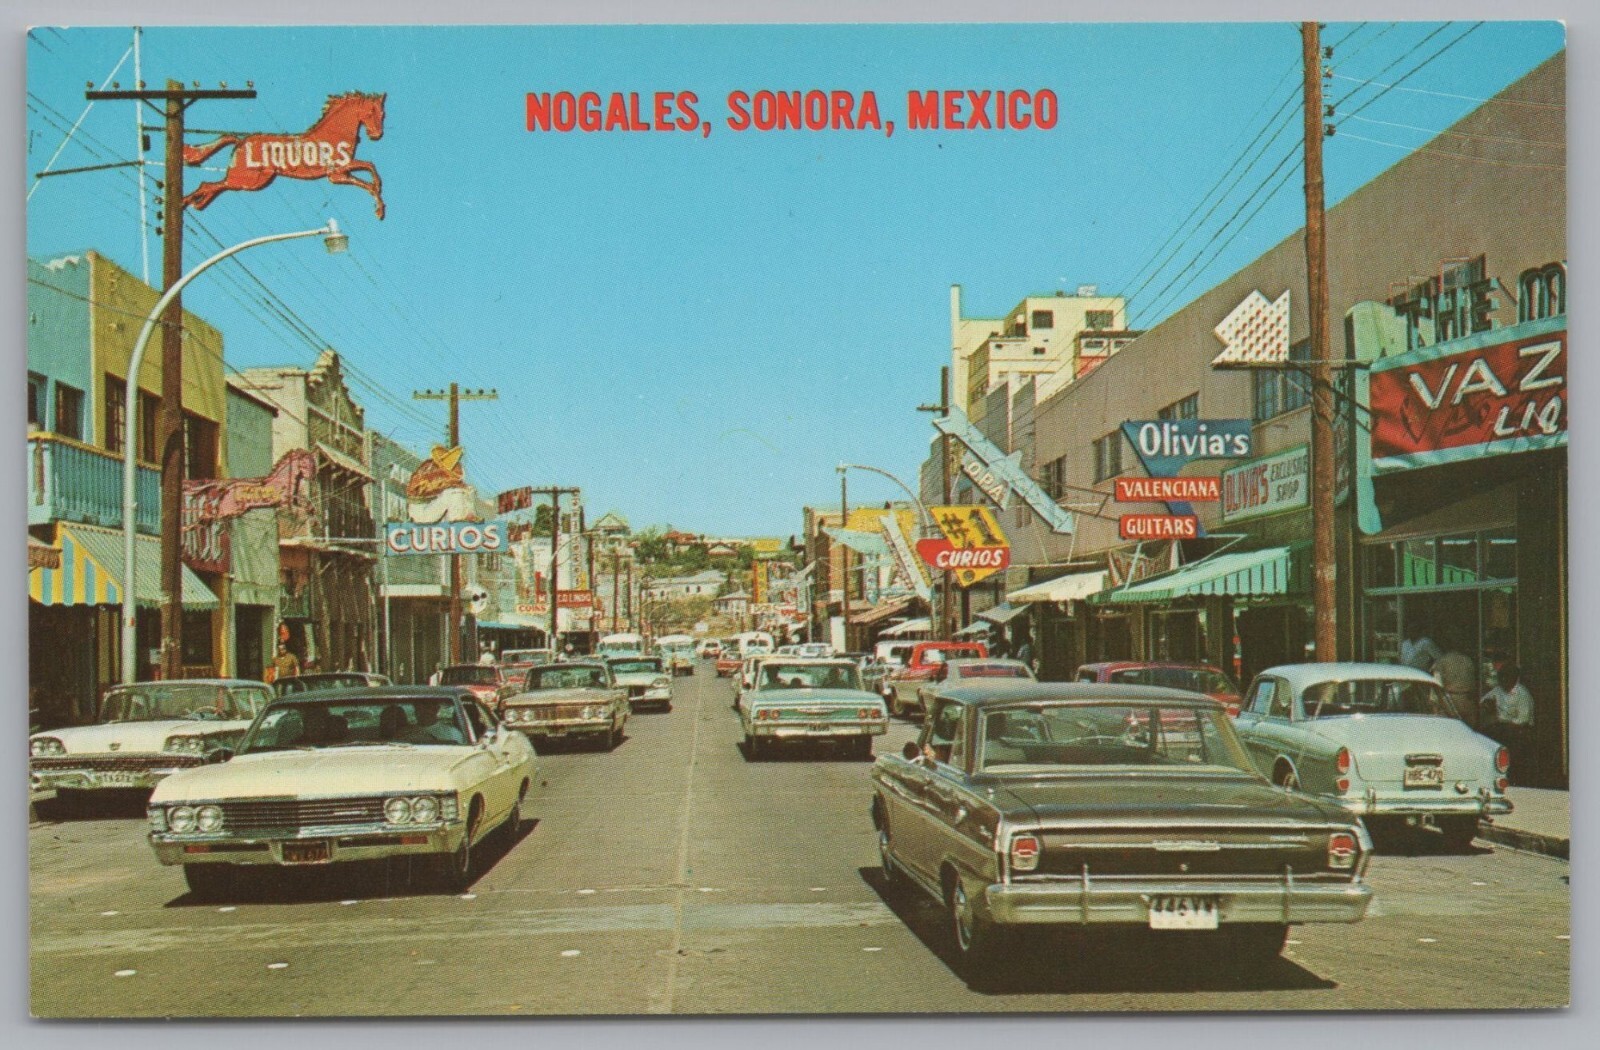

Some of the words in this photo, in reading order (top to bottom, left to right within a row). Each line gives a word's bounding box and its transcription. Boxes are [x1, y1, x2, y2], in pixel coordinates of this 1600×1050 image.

[245, 140, 351, 170] LIQUORS
[1394, 278, 1500, 351] THE
[1493, 395, 1563, 437] LIQ
[1138, 422, 1249, 457] Olivia's
[1119, 480, 1219, 498] VALENCIANA
[387, 525, 501, 552] CURIOS
[1125, 518, 1196, 535] GUITARS
[935, 549, 1005, 568] CURIOS
